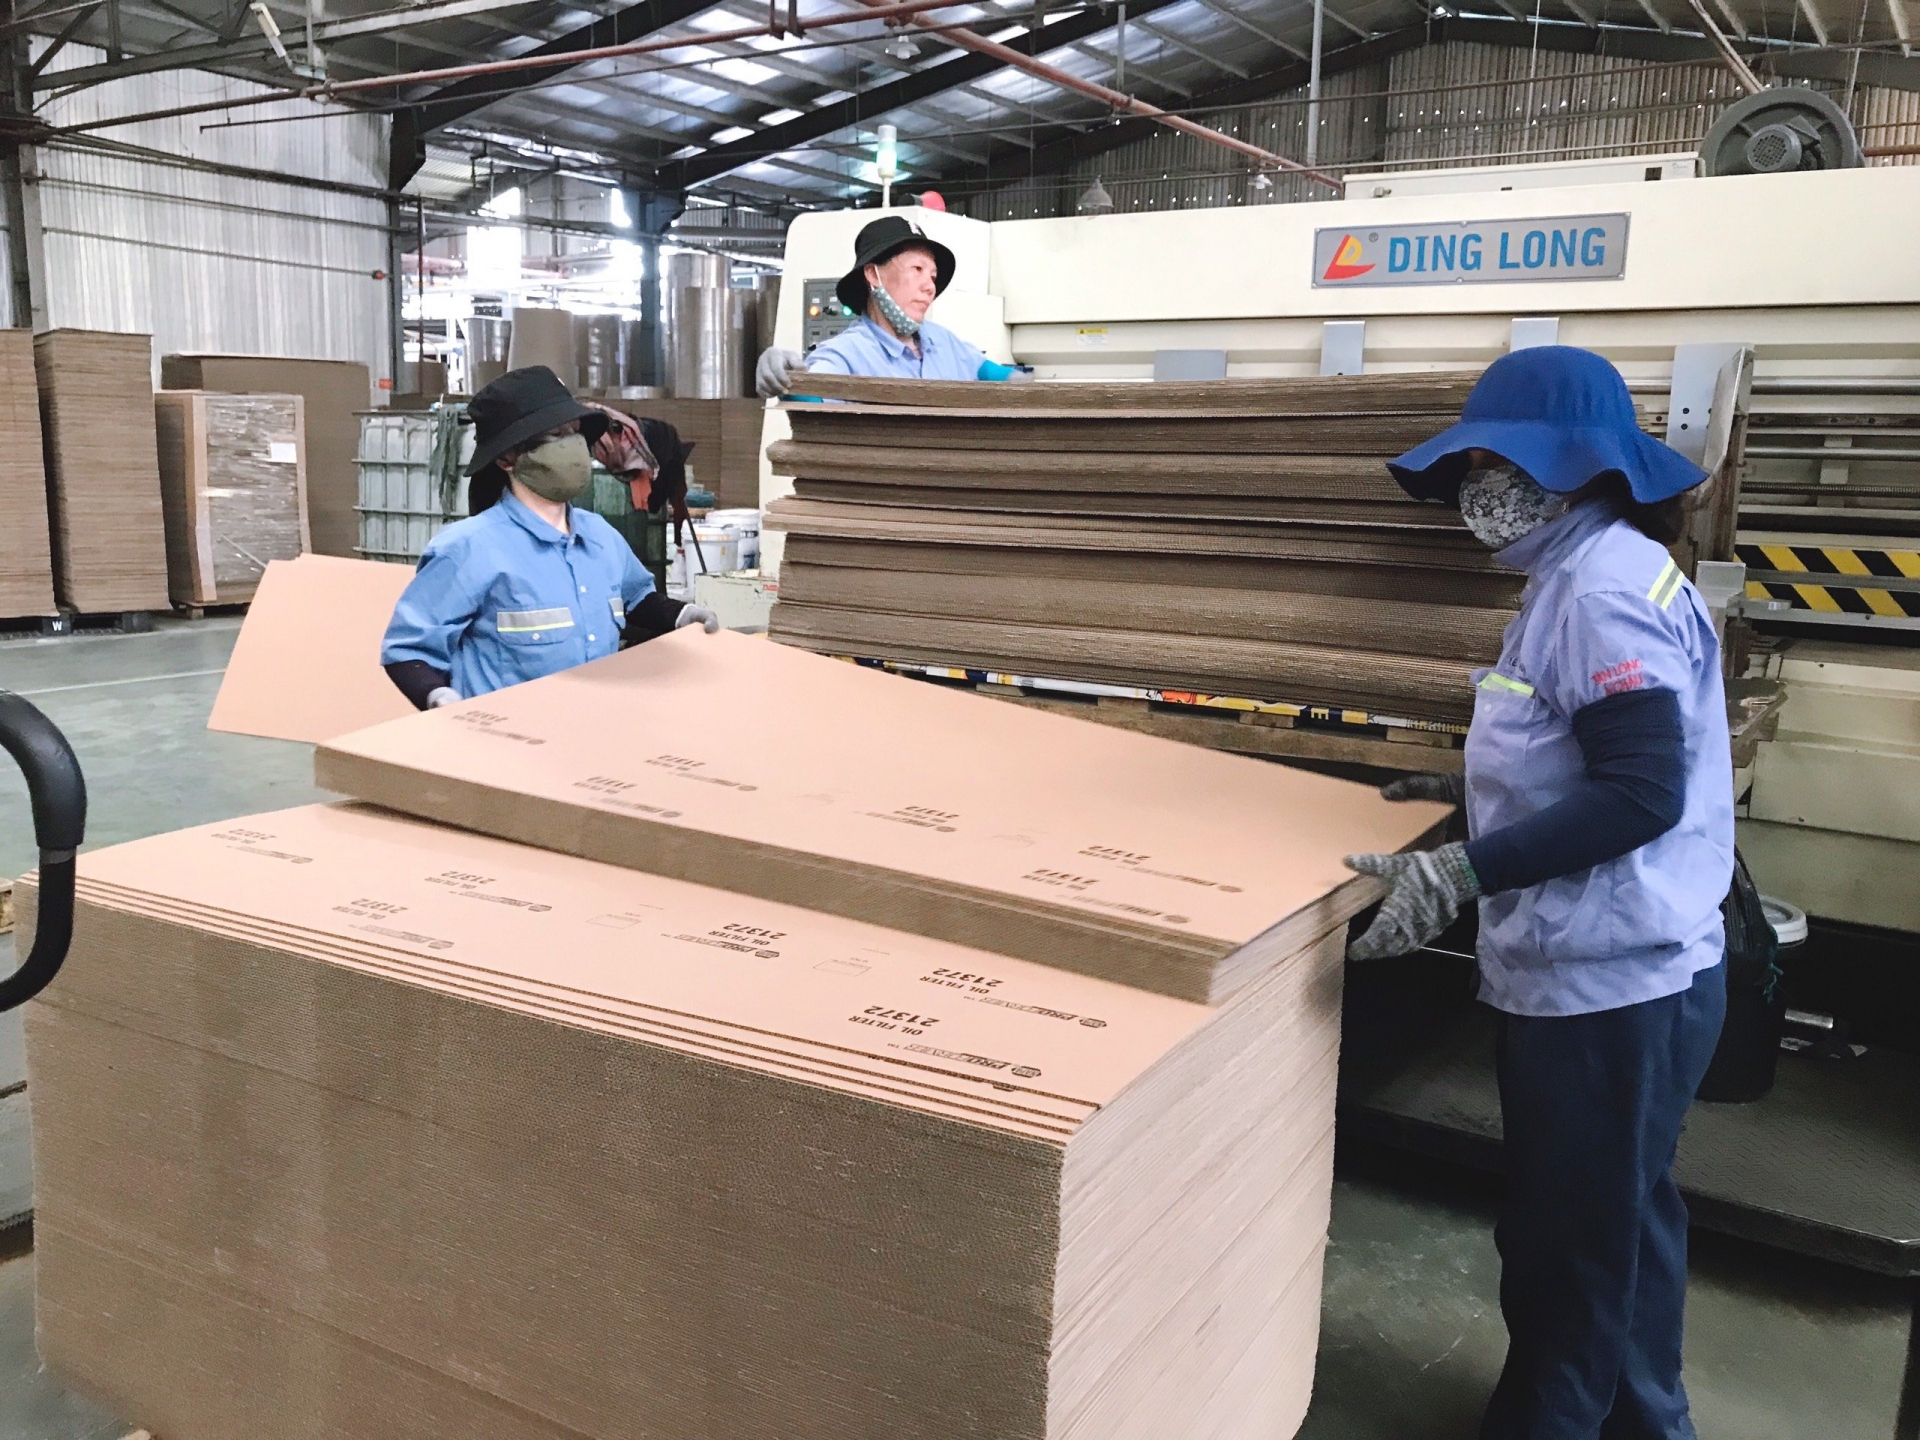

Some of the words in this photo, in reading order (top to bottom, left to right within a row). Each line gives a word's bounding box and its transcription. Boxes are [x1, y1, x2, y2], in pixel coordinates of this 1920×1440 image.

[1388, 233, 1482, 273] DING
[1499, 227, 1605, 269] LONG
[52, 620, 62, 631] W
[708, 930, 748, 942] FILTER
[723, 923, 787, 940] 21372
[919, 976, 964, 989] FILTER
[933, 968, 1004, 987] 21372
[968, 985, 990, 995] OIL
[848, 1015, 897, 1031] FILTER
[864, 1005, 940, 1027] 21372
[902, 1026, 923, 1036] OIL
